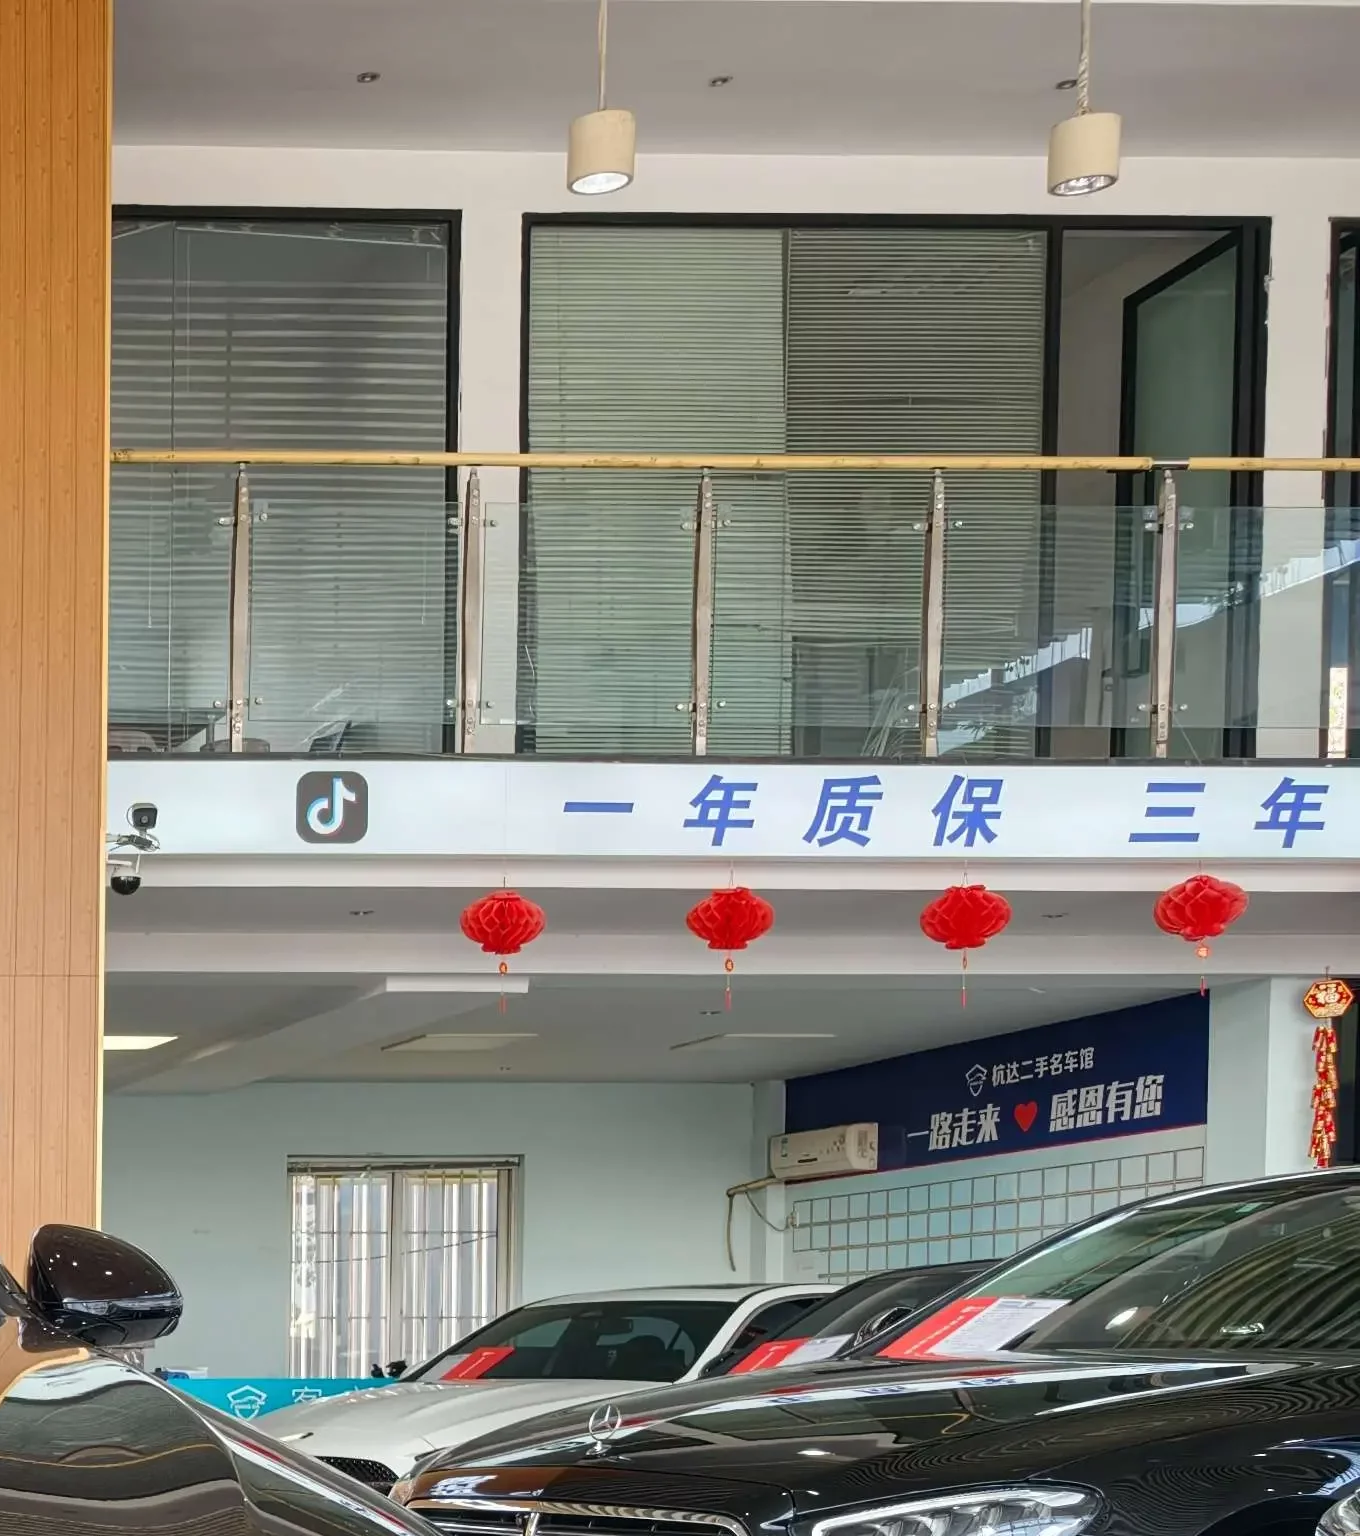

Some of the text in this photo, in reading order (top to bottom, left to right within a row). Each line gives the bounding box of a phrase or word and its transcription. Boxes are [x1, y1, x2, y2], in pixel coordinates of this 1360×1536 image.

[564, 775, 1329, 849] 一年质保 三年
[991, 1047, 1095, 1088] 杭达二手名车馆
[907, 1074, 1165, 1151] 一路走来 感恩有您
